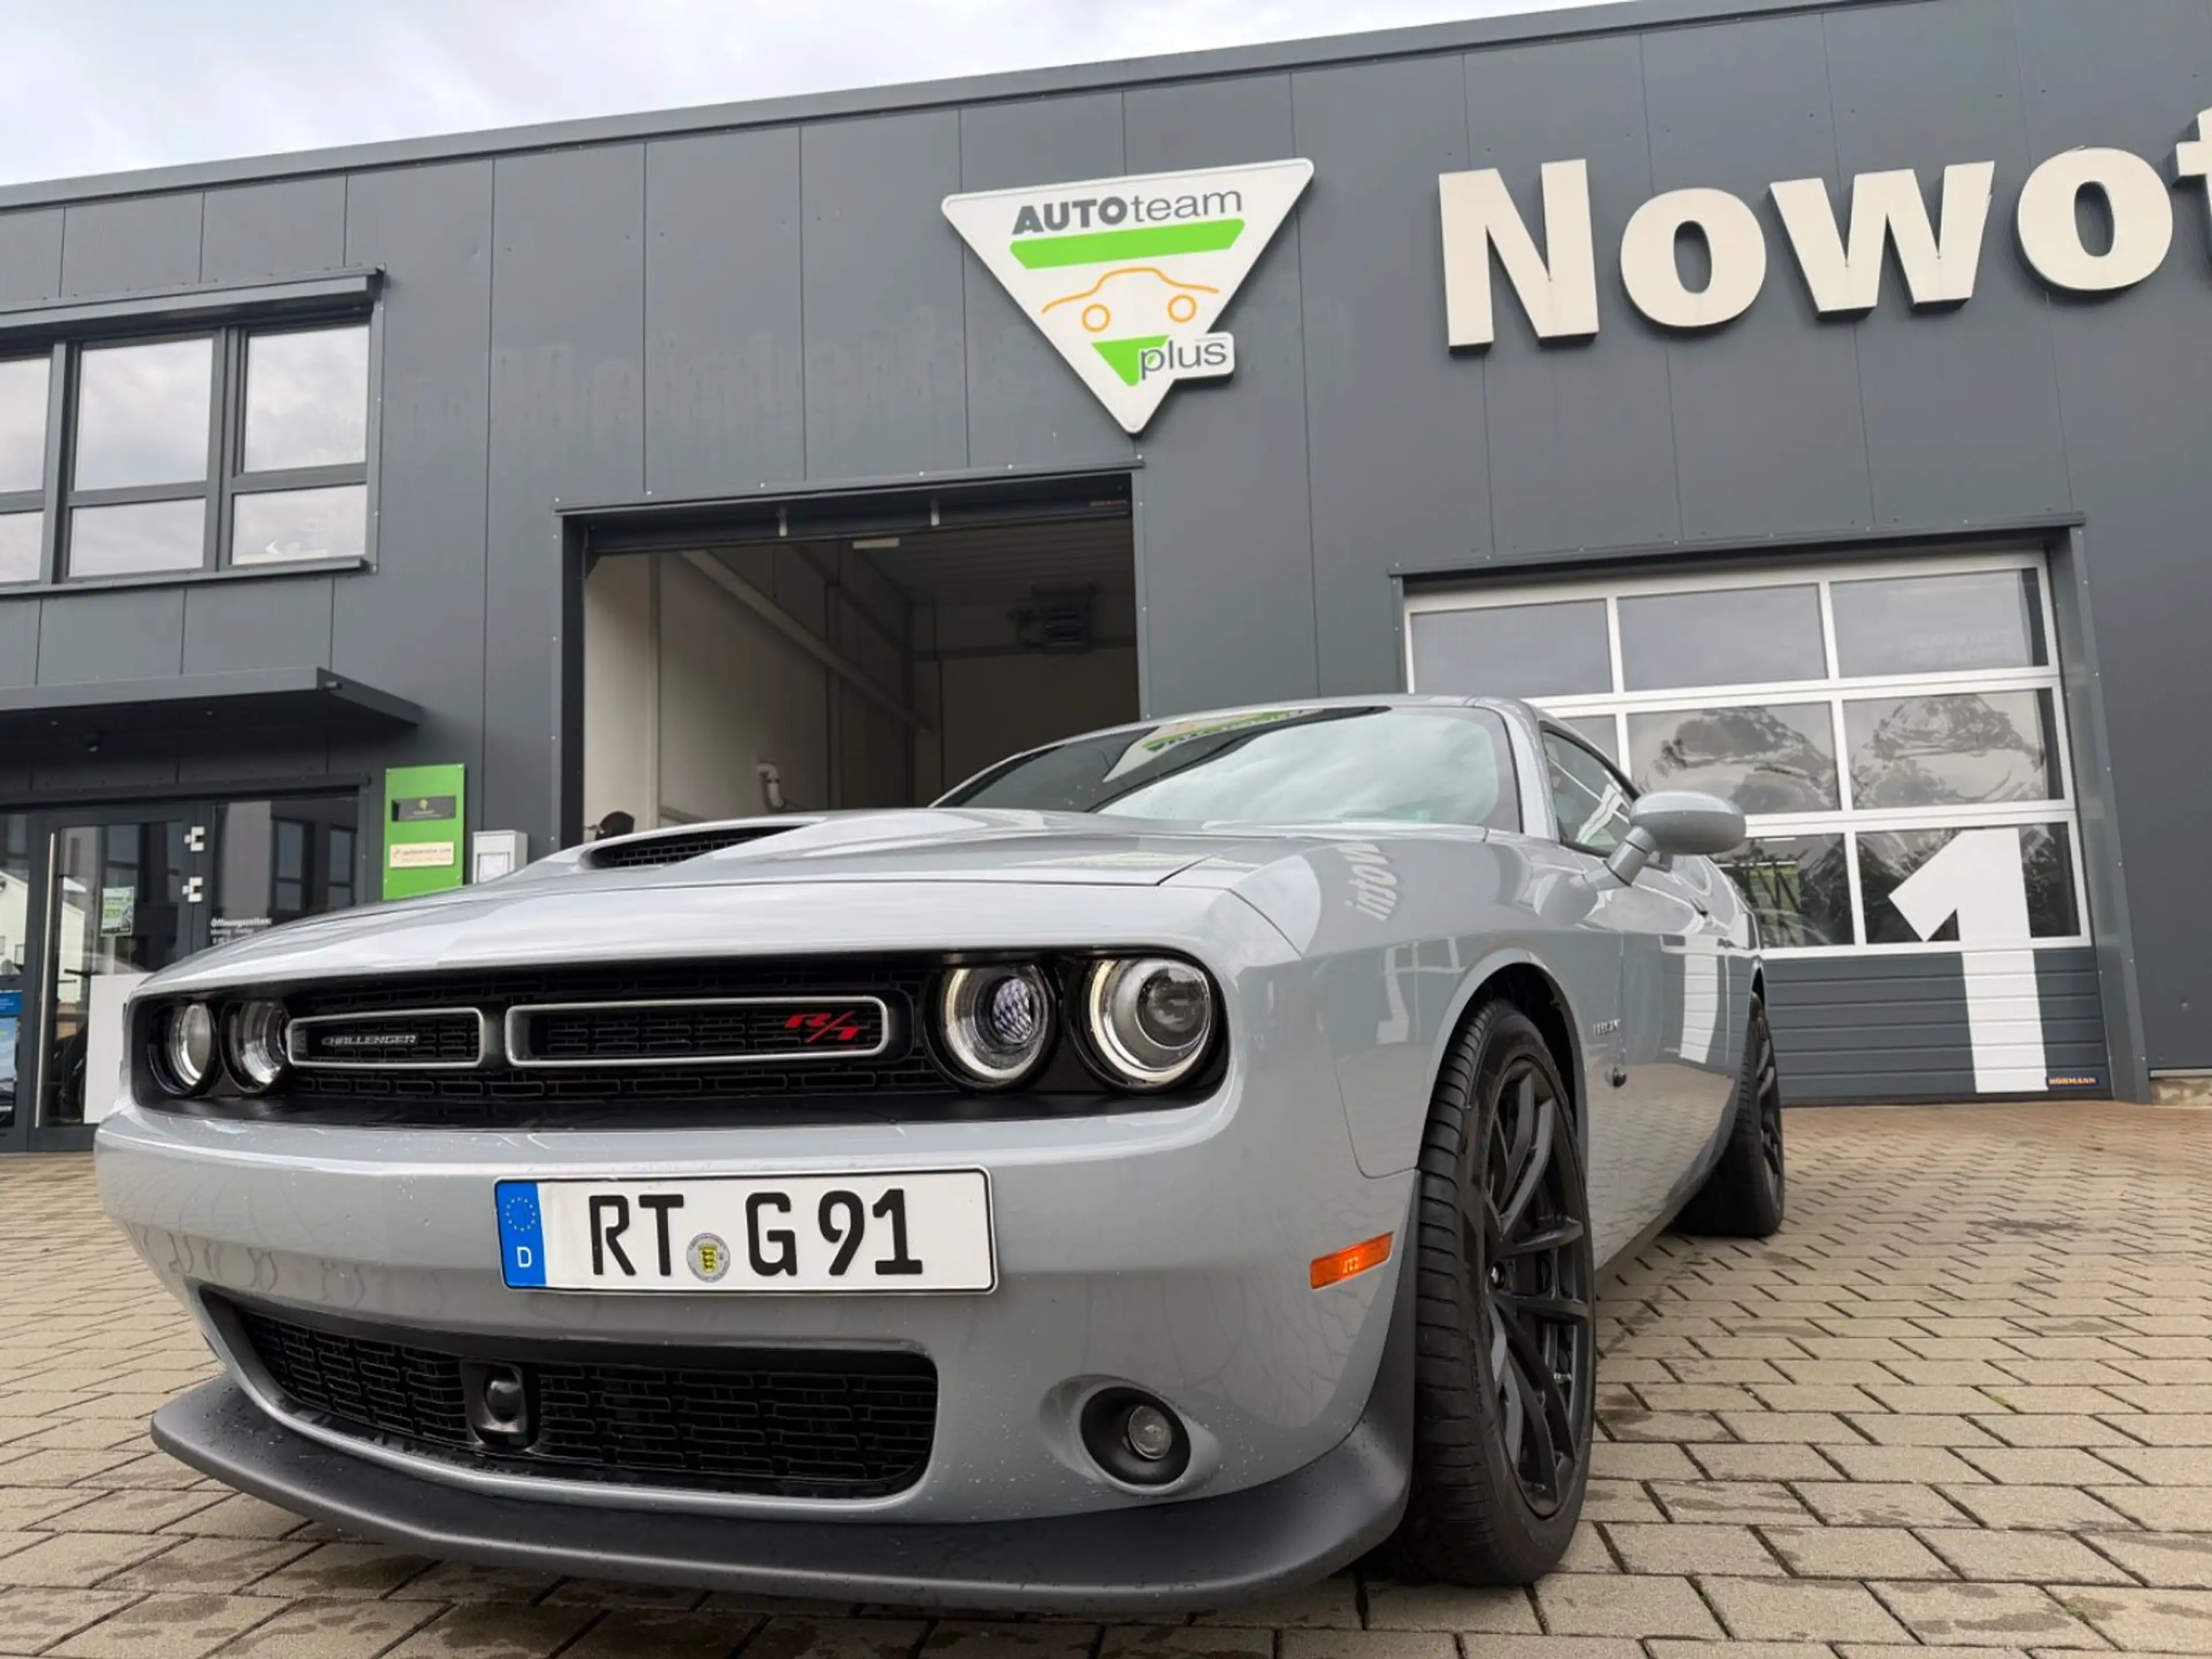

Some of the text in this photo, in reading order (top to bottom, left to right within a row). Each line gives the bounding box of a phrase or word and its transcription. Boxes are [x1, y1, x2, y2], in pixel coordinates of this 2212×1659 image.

[1012, 190, 1243, 235] AUTOteam
[1140, 339, 1228, 381] plus
[1888, 827, 2048, 1093] 1
[321, 1035, 418, 1047] CHALLENGER
[785, 1011, 869, 1043] R/T
[589, 1194, 684, 1277] RT
[517, 1246, 533, 1268] D
